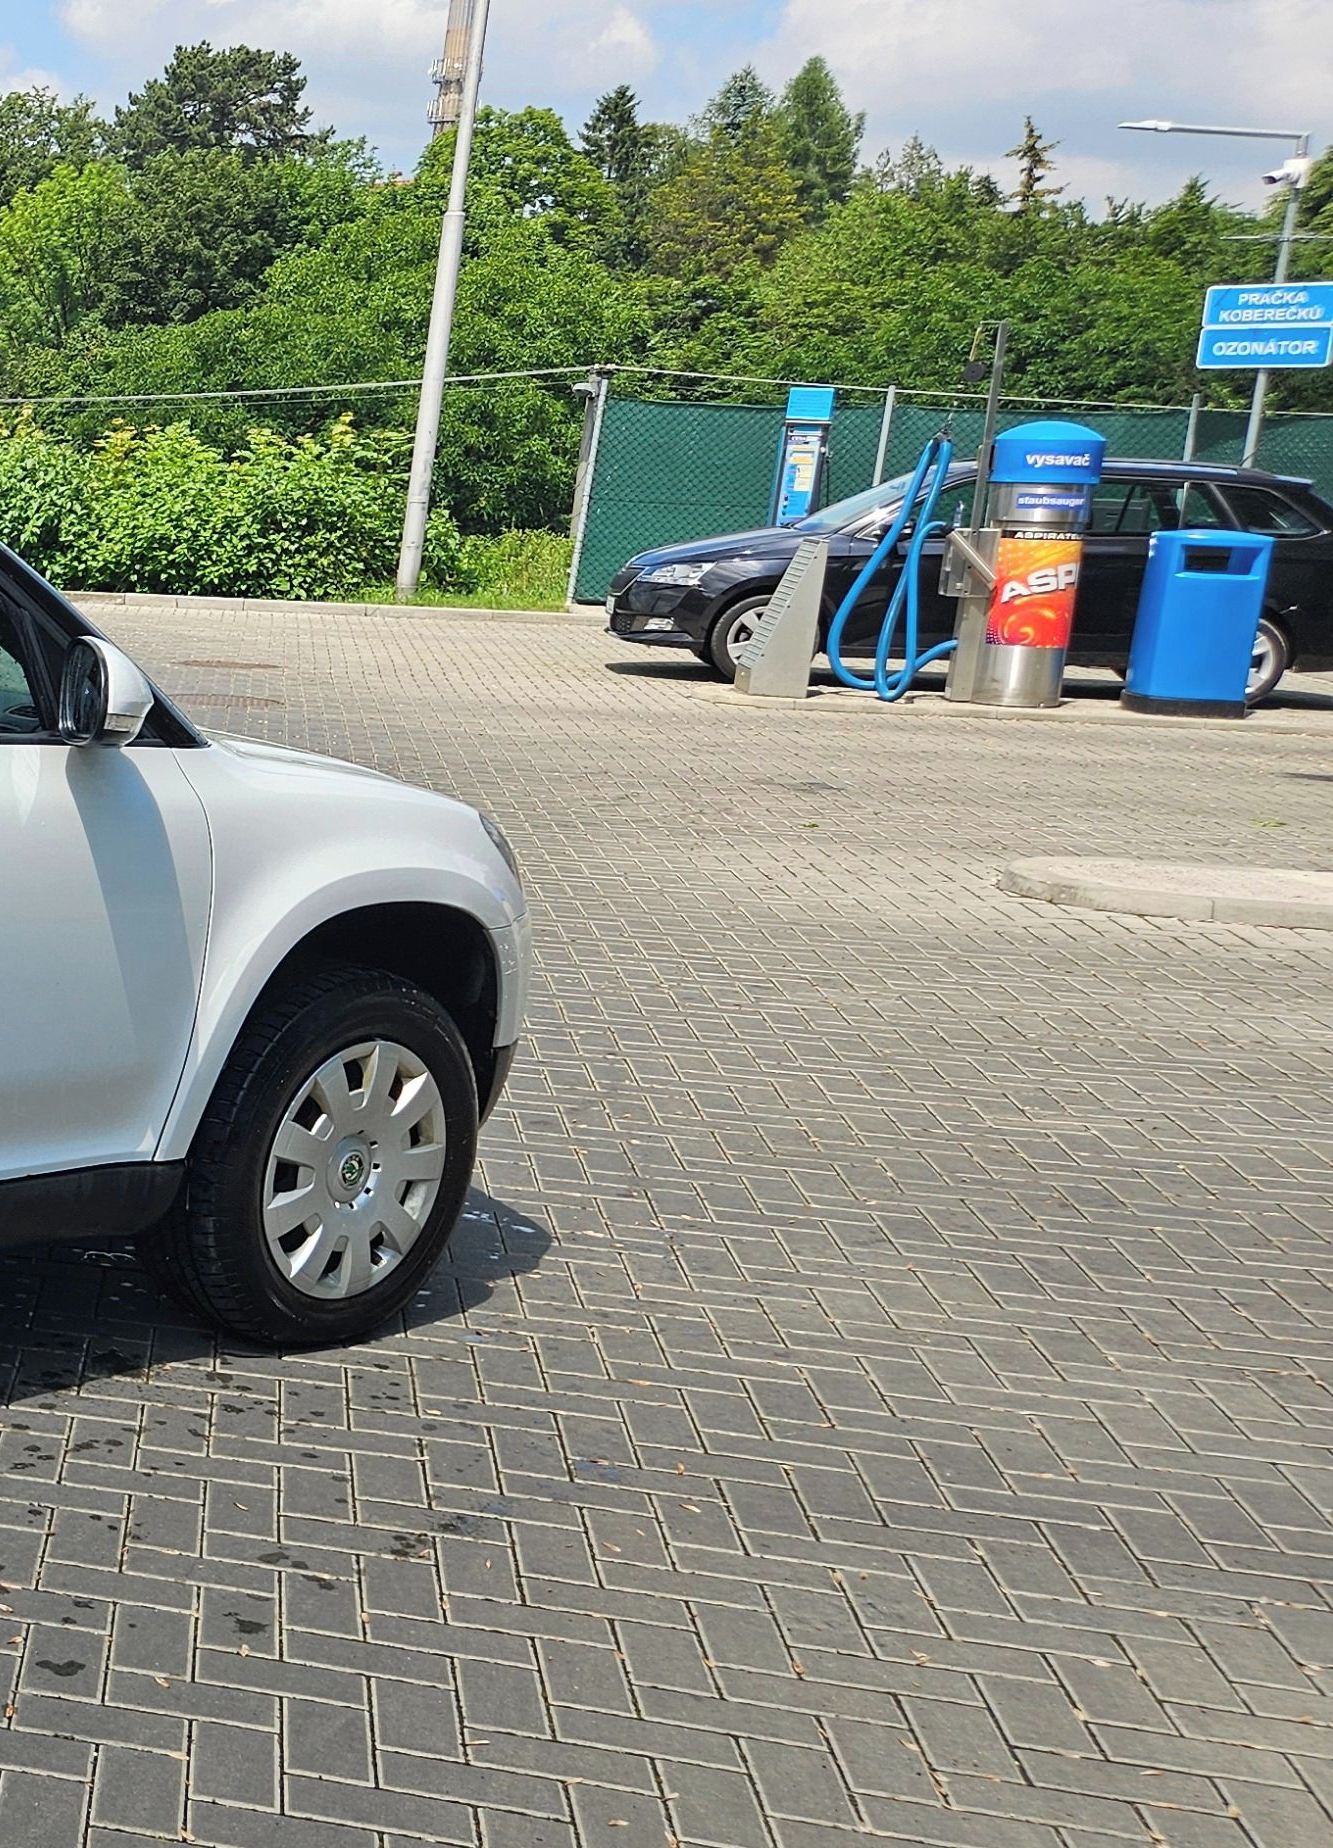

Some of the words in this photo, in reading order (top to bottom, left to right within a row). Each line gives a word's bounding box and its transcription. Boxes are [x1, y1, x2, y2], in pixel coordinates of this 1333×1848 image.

[1238, 290, 1309, 306] PRAČKA
[1212, 338, 1319, 356] OZONÁTOR
[1025, 453, 1091, 468] vysavač
[1018, 496, 1085, 508] staubsauger
[1000, 562, 1080, 604] ASP
